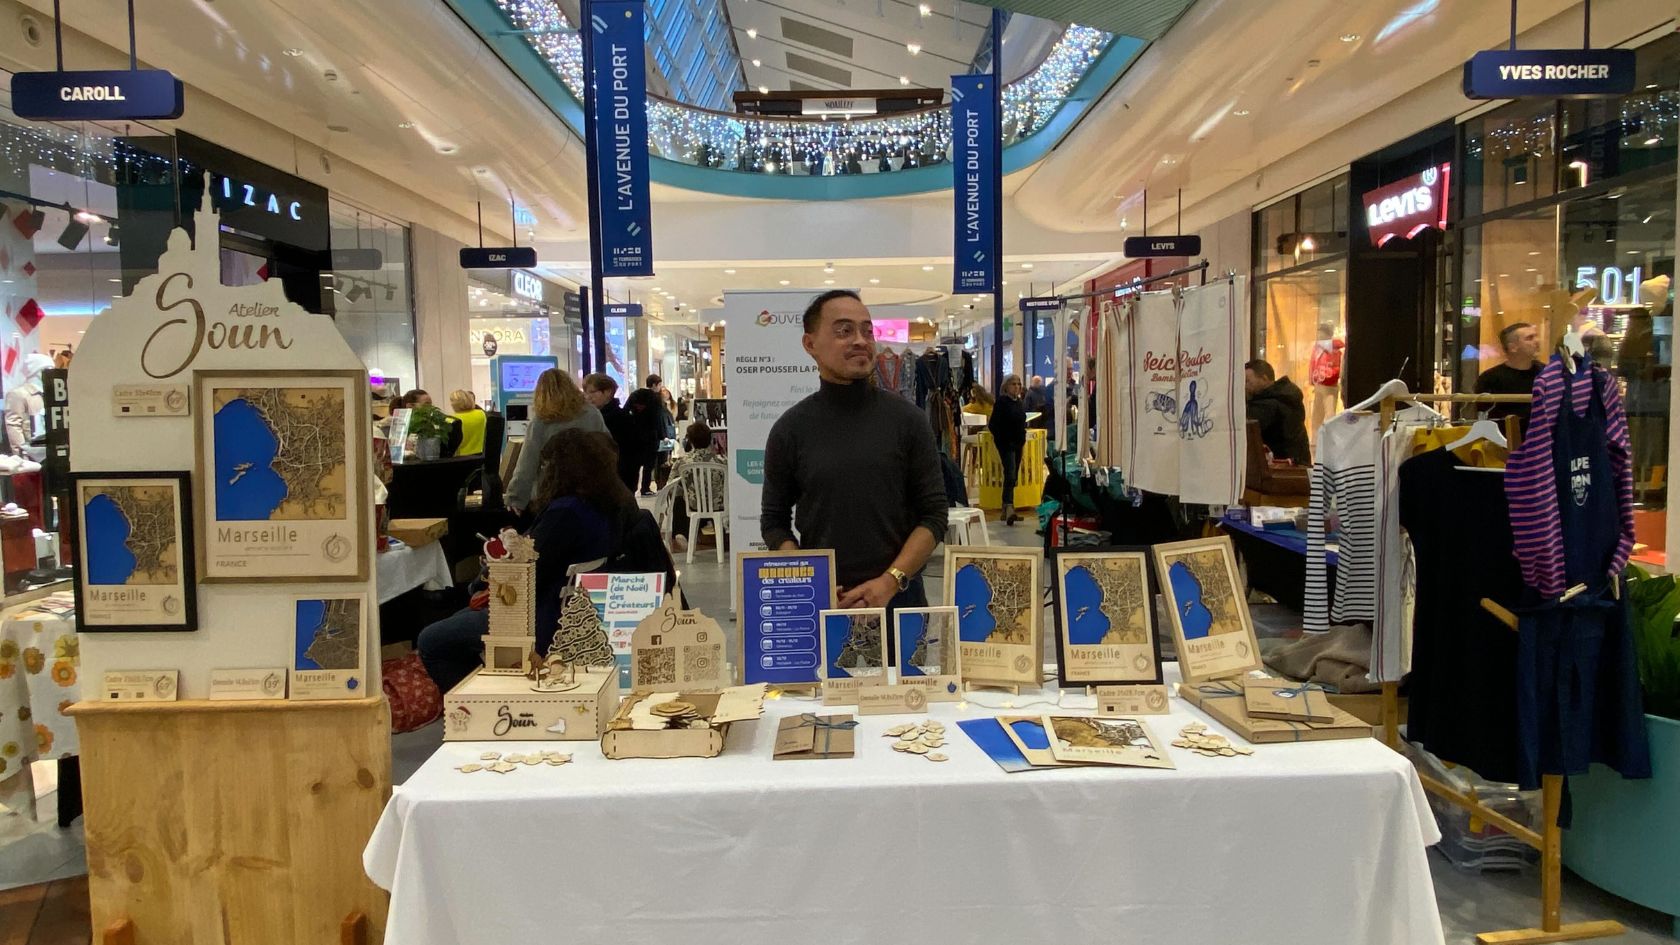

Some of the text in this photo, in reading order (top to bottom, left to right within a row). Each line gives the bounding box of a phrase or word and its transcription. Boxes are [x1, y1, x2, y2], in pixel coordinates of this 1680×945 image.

[1499, 65, 1609, 80] YVES ROCHER
[60, 86, 126, 101] CAROLL
[612, 44, 633, 211] L'AVENUE DU PORT
[967, 109, 980, 242] L'AVENUE DU PORT
[223, 177, 302, 221] IZAC
[488, 254, 507, 262] IZAC
[1576, 266, 1642, 305] 501
[229, 302, 280, 318] Atelier
[141, 272, 293, 379] Soun
[760, 365, 798, 373] POUSSER
[743, 399, 780, 408] Rejoignez
[218, 527, 298, 543] Marseille
[611, 575, 646, 583] Marché
[90, 588, 146, 601] Marseille
[610, 583, 649, 592] (de Noël)
[608, 601, 655, 609] Créateurs
[959, 647, 1002, 658] arseille
[1187, 639, 1225, 654] Marseille
[1071, 649, 1121, 660] Marseille
[295, 673, 336, 683] Marseille
[827, 680, 864, 689] Marseille
[493, 705, 538, 737] Soun
